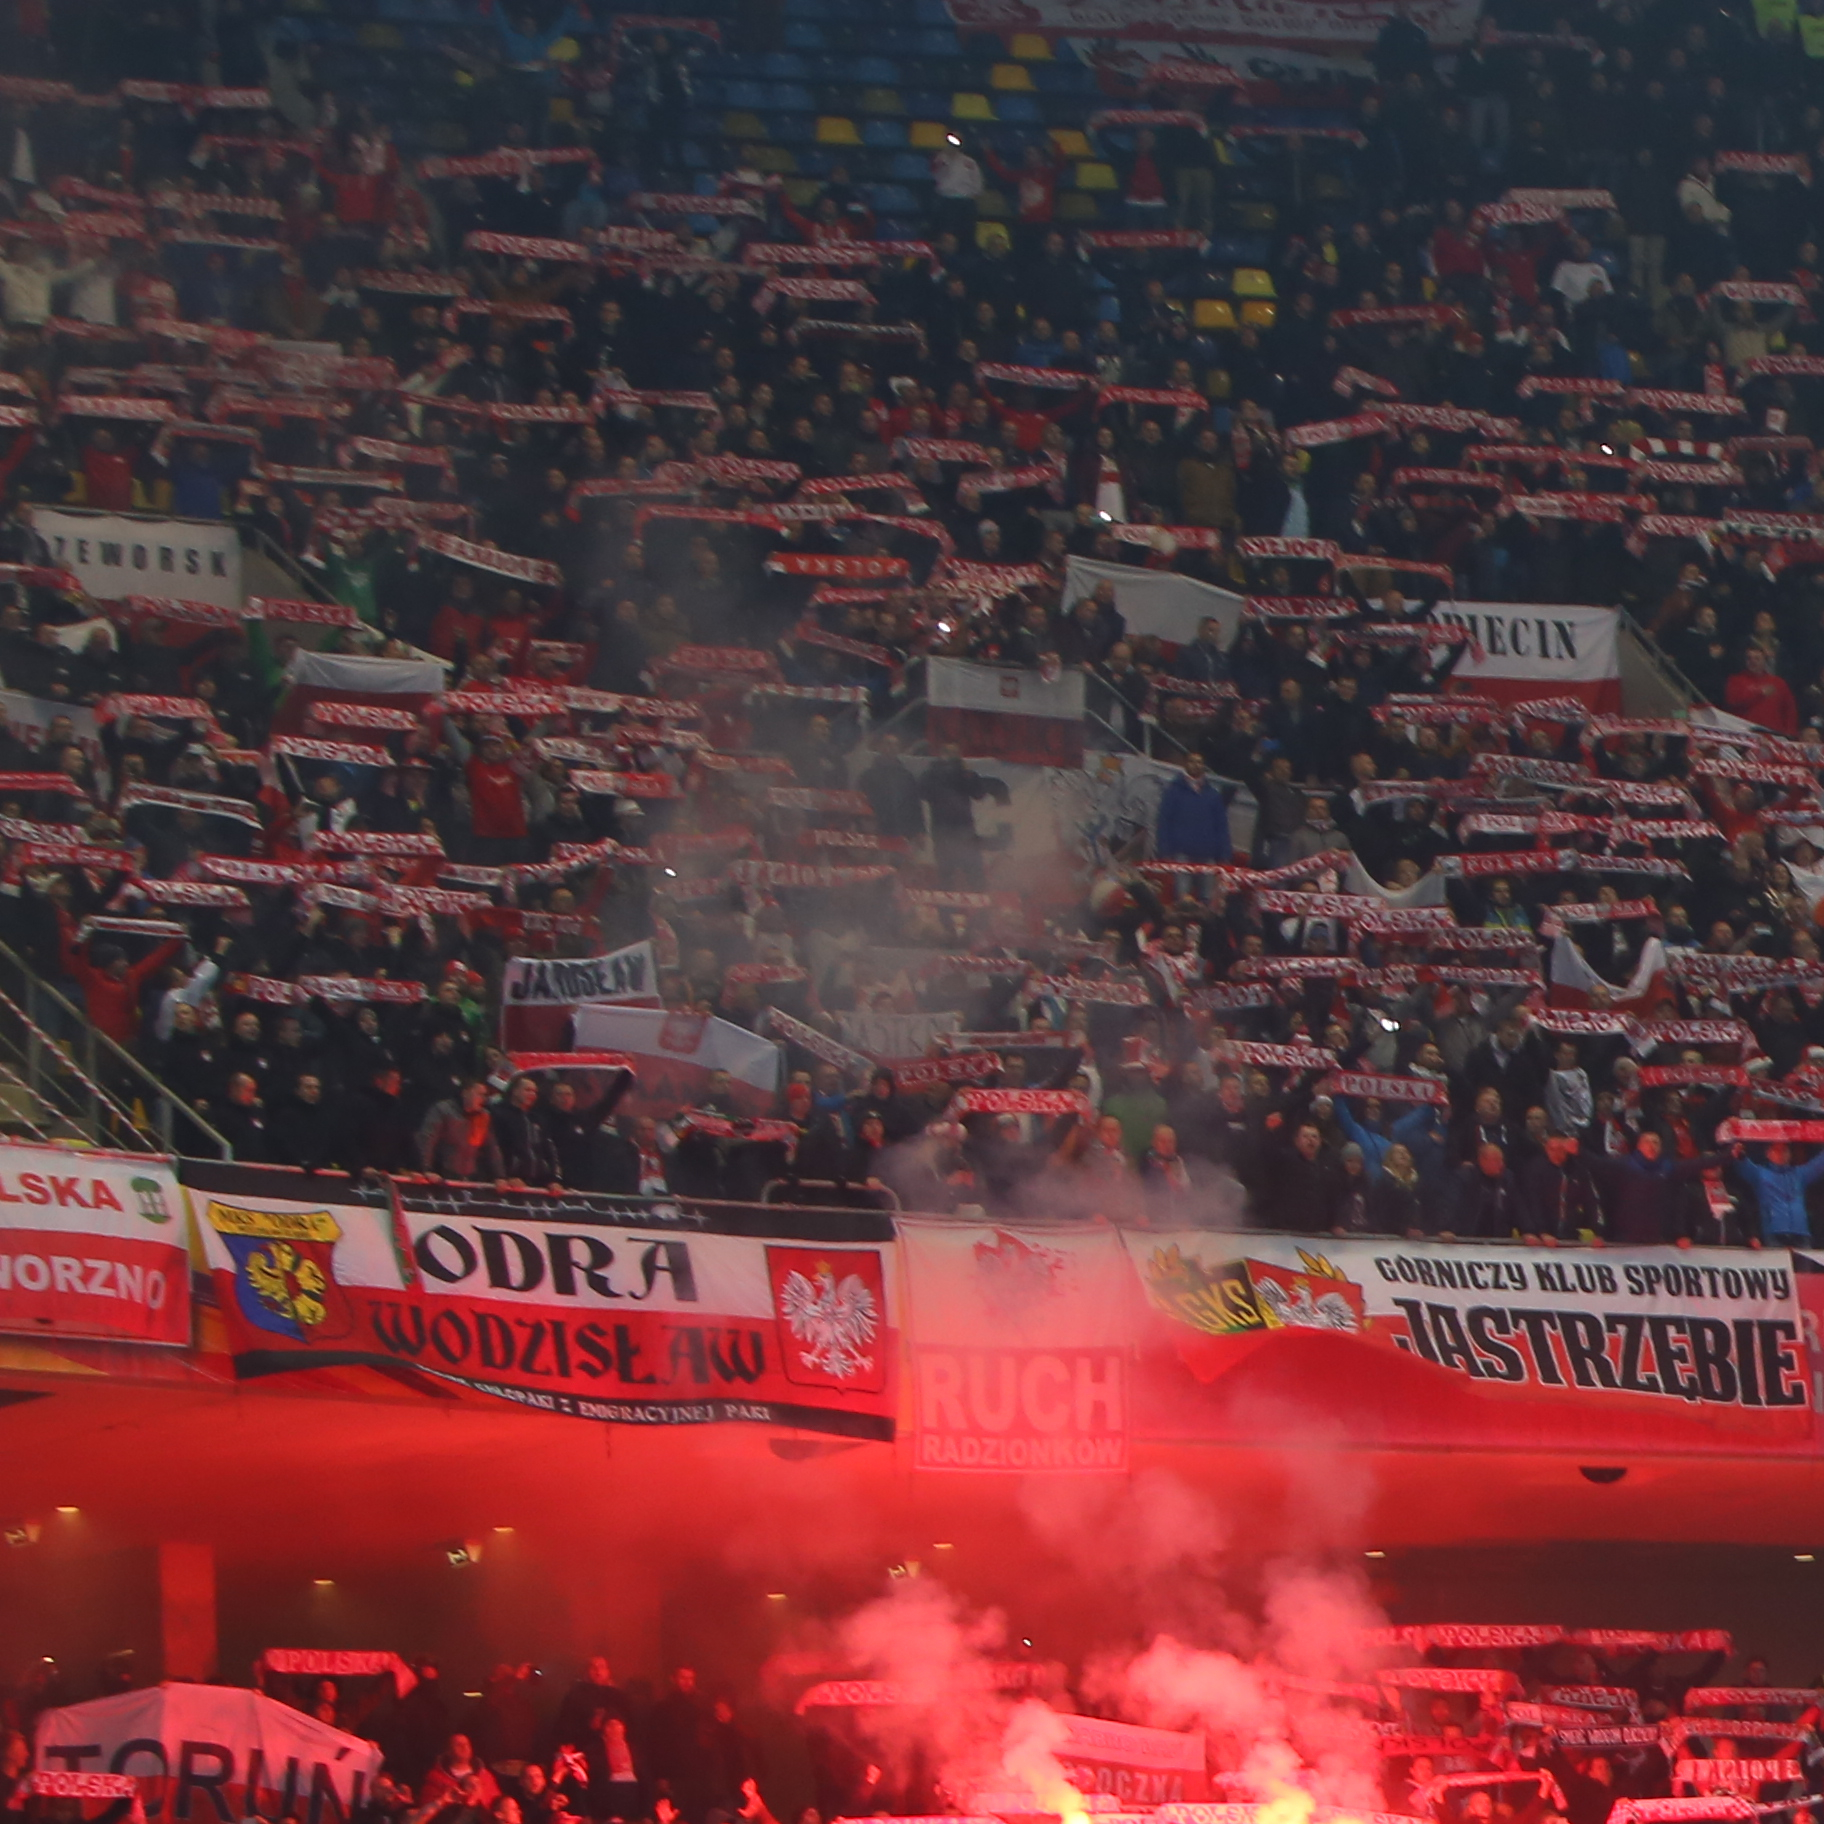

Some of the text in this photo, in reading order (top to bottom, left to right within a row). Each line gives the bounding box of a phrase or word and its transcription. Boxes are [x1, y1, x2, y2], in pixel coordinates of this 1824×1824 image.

[415, 1222, 700, 1305] ODRA
[1375, 1253, 1791, 1300] GÓRNICZY KLUB SPORTOWY
[369, 1298, 766, 1386] WODZISŁAW
[1393, 1297, 1807, 1407] JASTRZĘBIE
[726, 1404, 770, 1421] PAKI
[919, 1354, 1123, 1432] RUCH
